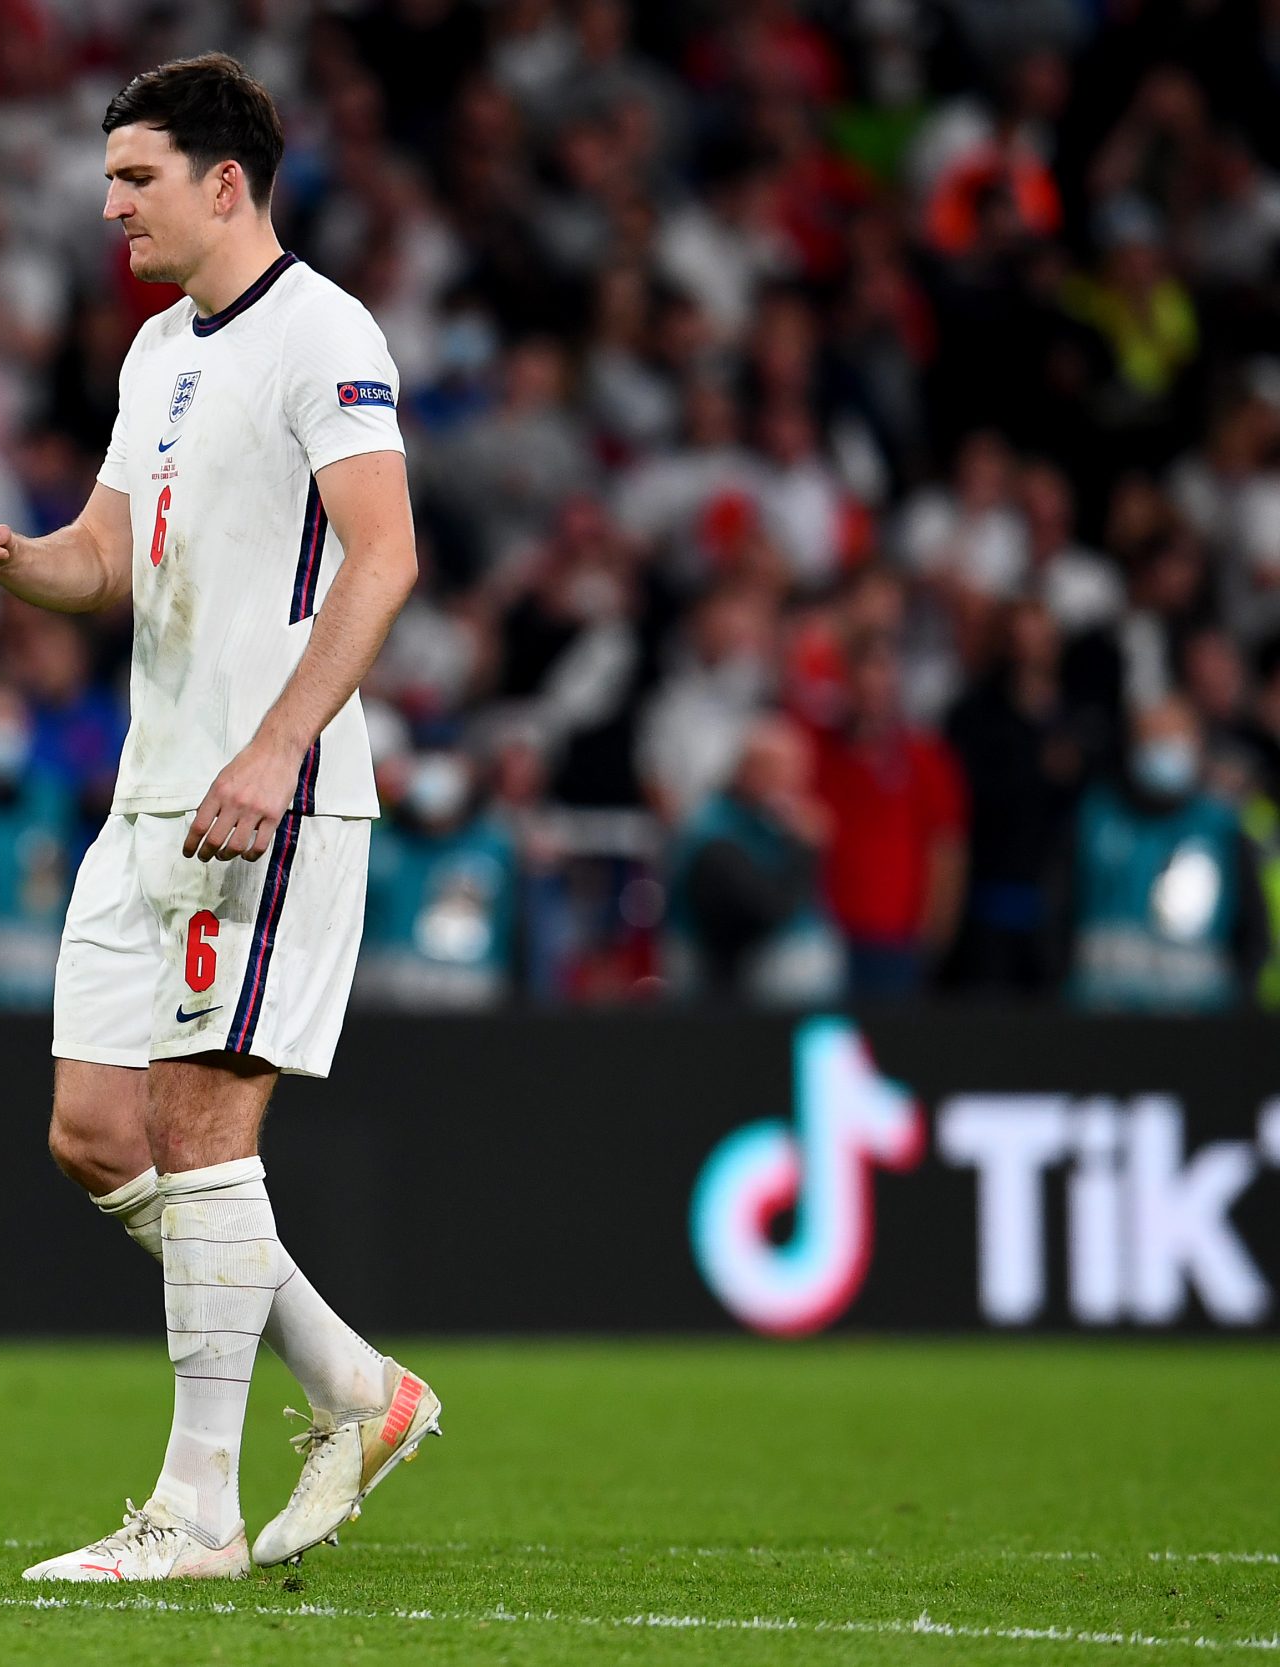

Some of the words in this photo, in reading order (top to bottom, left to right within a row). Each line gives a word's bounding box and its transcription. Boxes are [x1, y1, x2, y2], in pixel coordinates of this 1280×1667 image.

[150, 485, 172, 567] 6
[185, 909, 220, 993] 6
[937, 1092, 1280, 1326] Tik
[380, 1375, 424, 1447] PUMA
